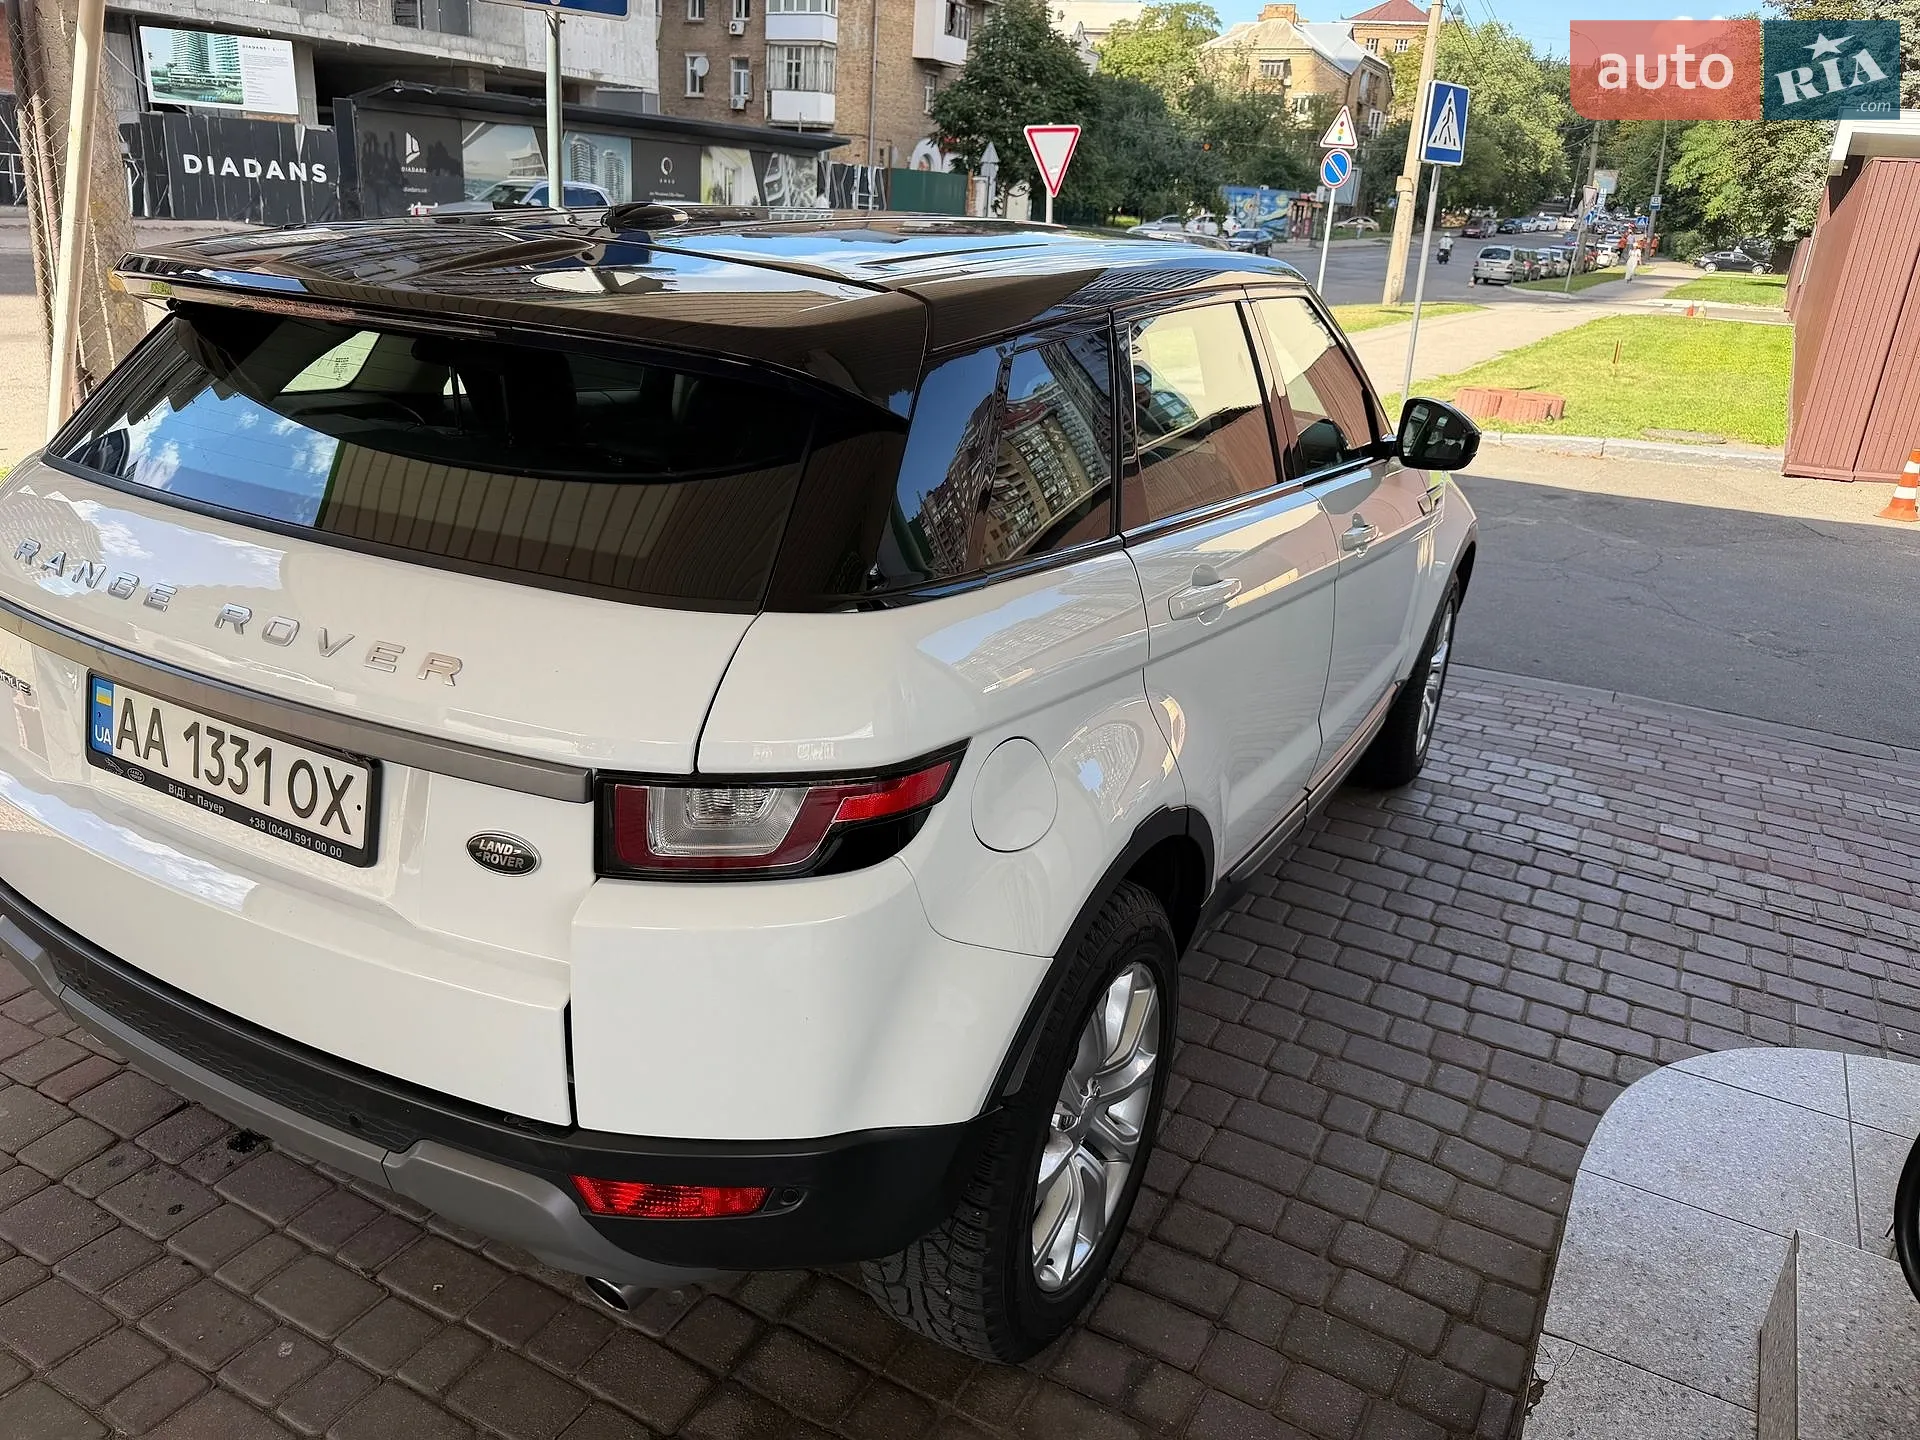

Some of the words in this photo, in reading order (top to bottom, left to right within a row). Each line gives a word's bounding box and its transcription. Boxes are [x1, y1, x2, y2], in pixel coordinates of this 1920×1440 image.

[183, 153, 328, 183] DIADANS
[14, 537, 178, 613] RANGE
[214, 602, 463, 687] ROVER
[95, 724, 112, 746] UA
[115, 697, 169, 768] AA
[183, 721, 273, 807] 1331
[287, 759, 354, 836] OX
[197, 794, 225, 815] Пауер
[249, 816, 266, 830] +38
[268, 822, 292, 841] (044)
[294, 832, 312, 847] 591
[315, 840, 327, 853] 00
[330, 845, 343, 859] 00
[479, 839, 514, 855] LAND
[482, 851, 525, 869] ROVER
